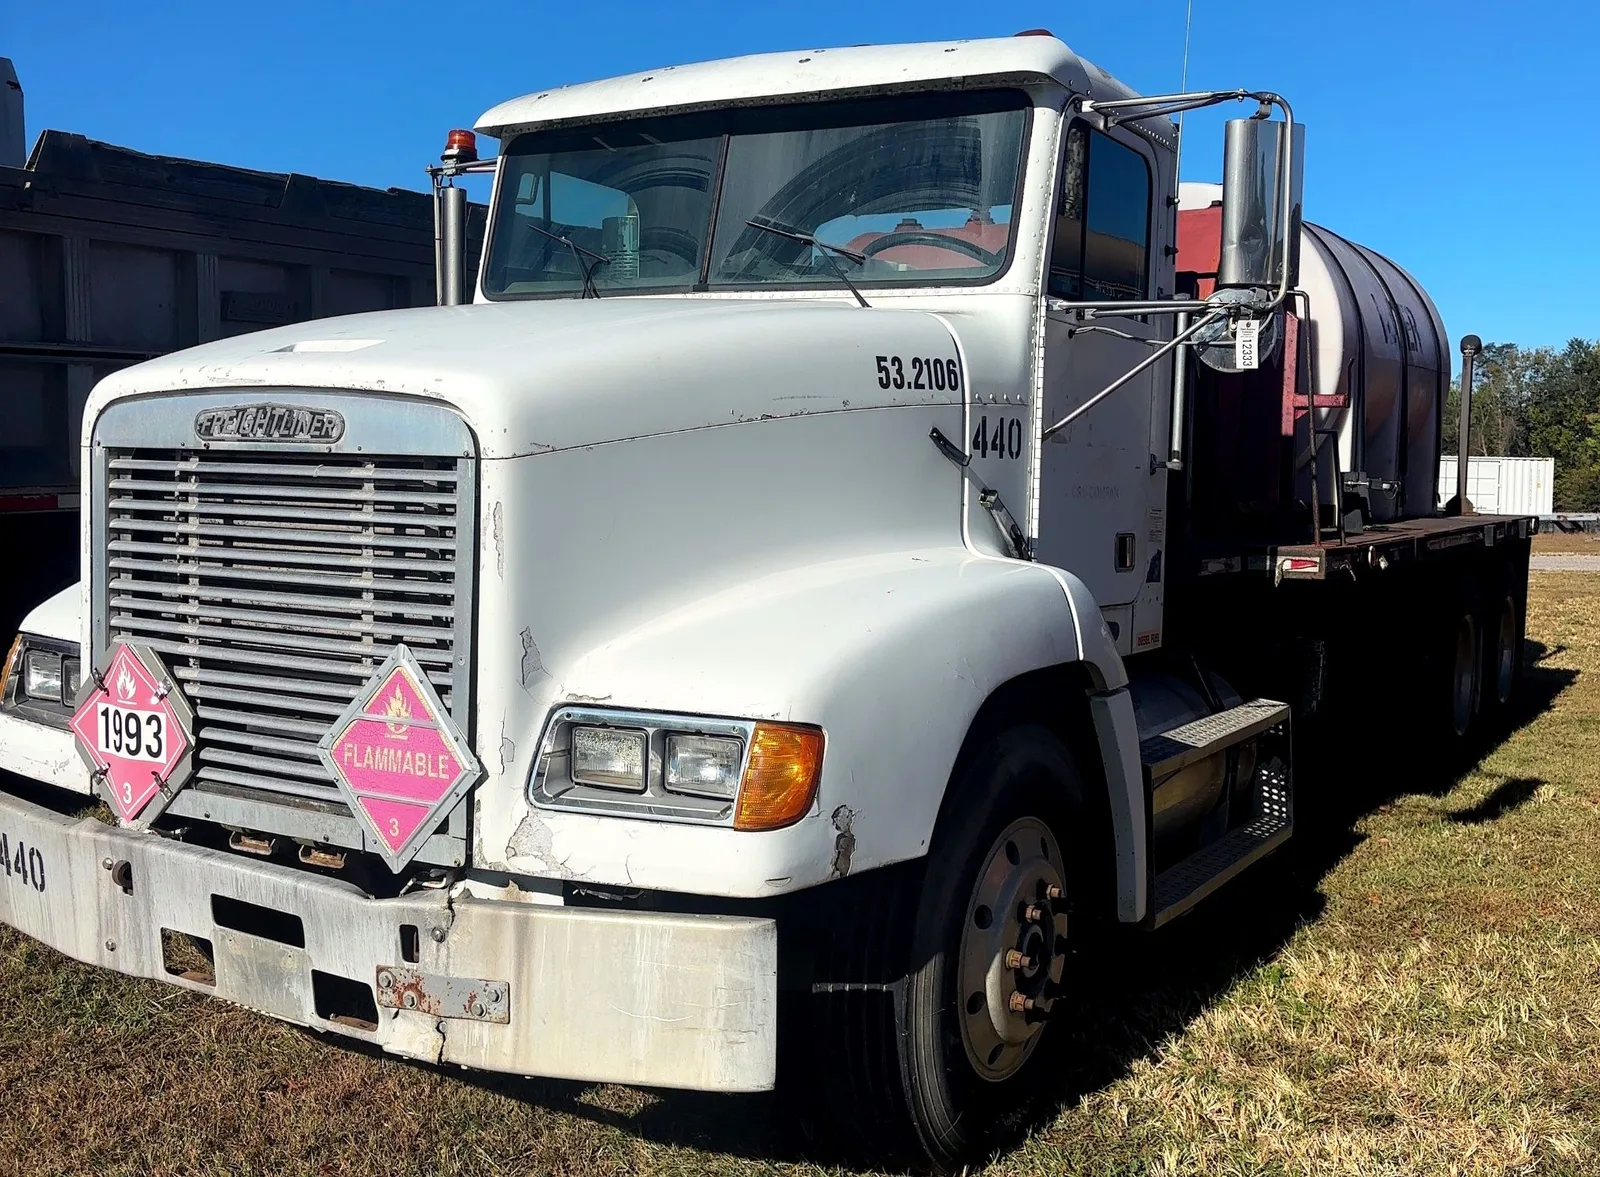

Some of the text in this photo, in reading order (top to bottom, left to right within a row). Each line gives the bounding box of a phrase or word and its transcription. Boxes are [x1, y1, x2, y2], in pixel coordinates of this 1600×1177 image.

[1242, 339, 1253, 366] 12333
[876, 355, 959, 391] 53.2106
[200, 407, 337, 436] FREIGHTLINER
[972, 416, 1022, 460] 440
[1137, 632, 1160, 646] DIESEL FUEL
[101, 707, 163, 759] 1993
[343, 742, 450, 779] FLAMMABLE
[122, 782, 132, 804] 3
[388, 817, 400, 837] 3
[0, 832, 46, 893] 440
